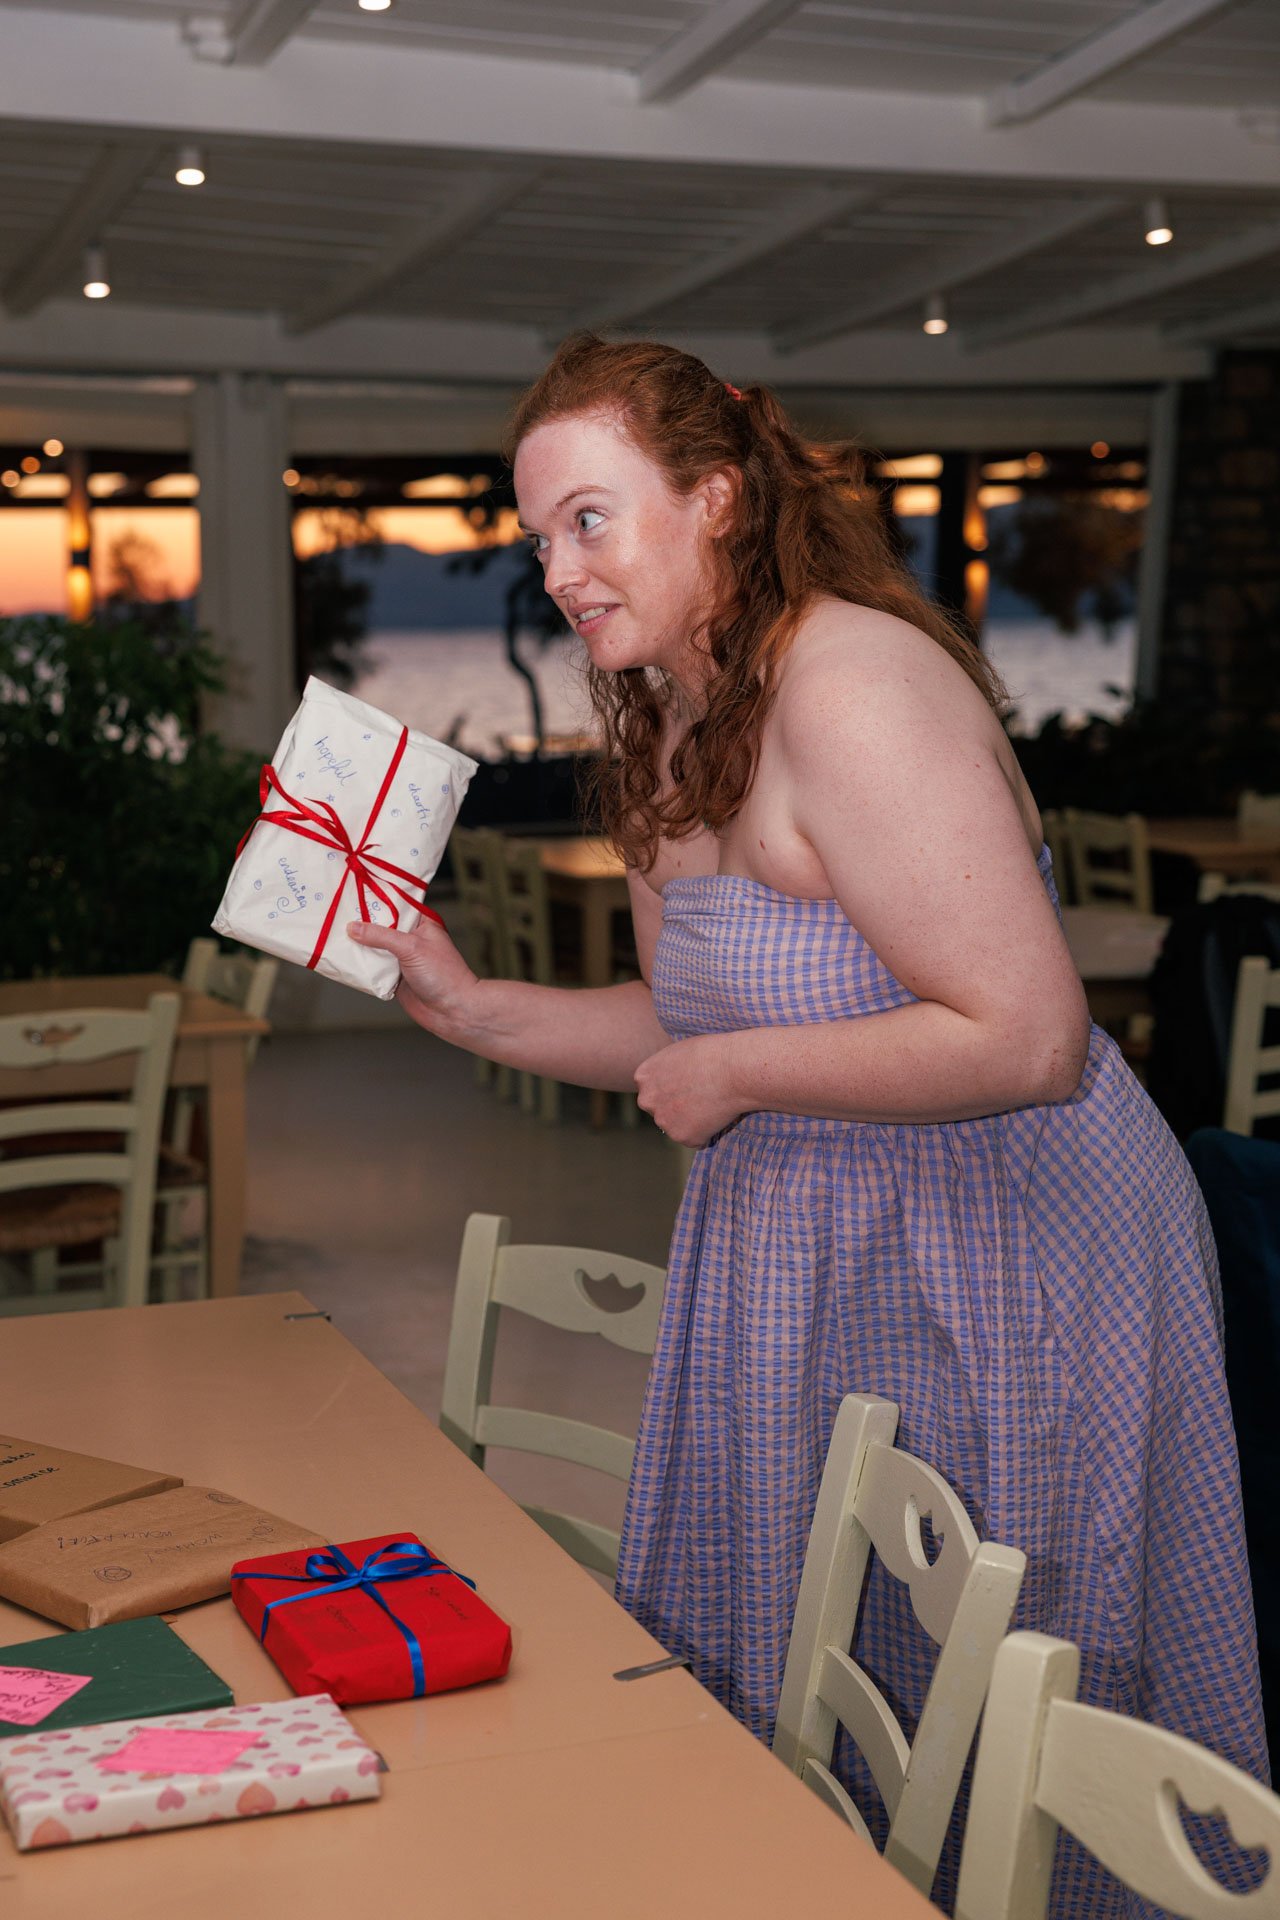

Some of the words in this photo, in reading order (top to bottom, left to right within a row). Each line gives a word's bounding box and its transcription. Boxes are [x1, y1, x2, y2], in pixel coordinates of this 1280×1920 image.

[314, 736, 357, 786] hopeful
[408, 783, 430, 830] chaotic
[0, 1467, 60, 1489] omance
